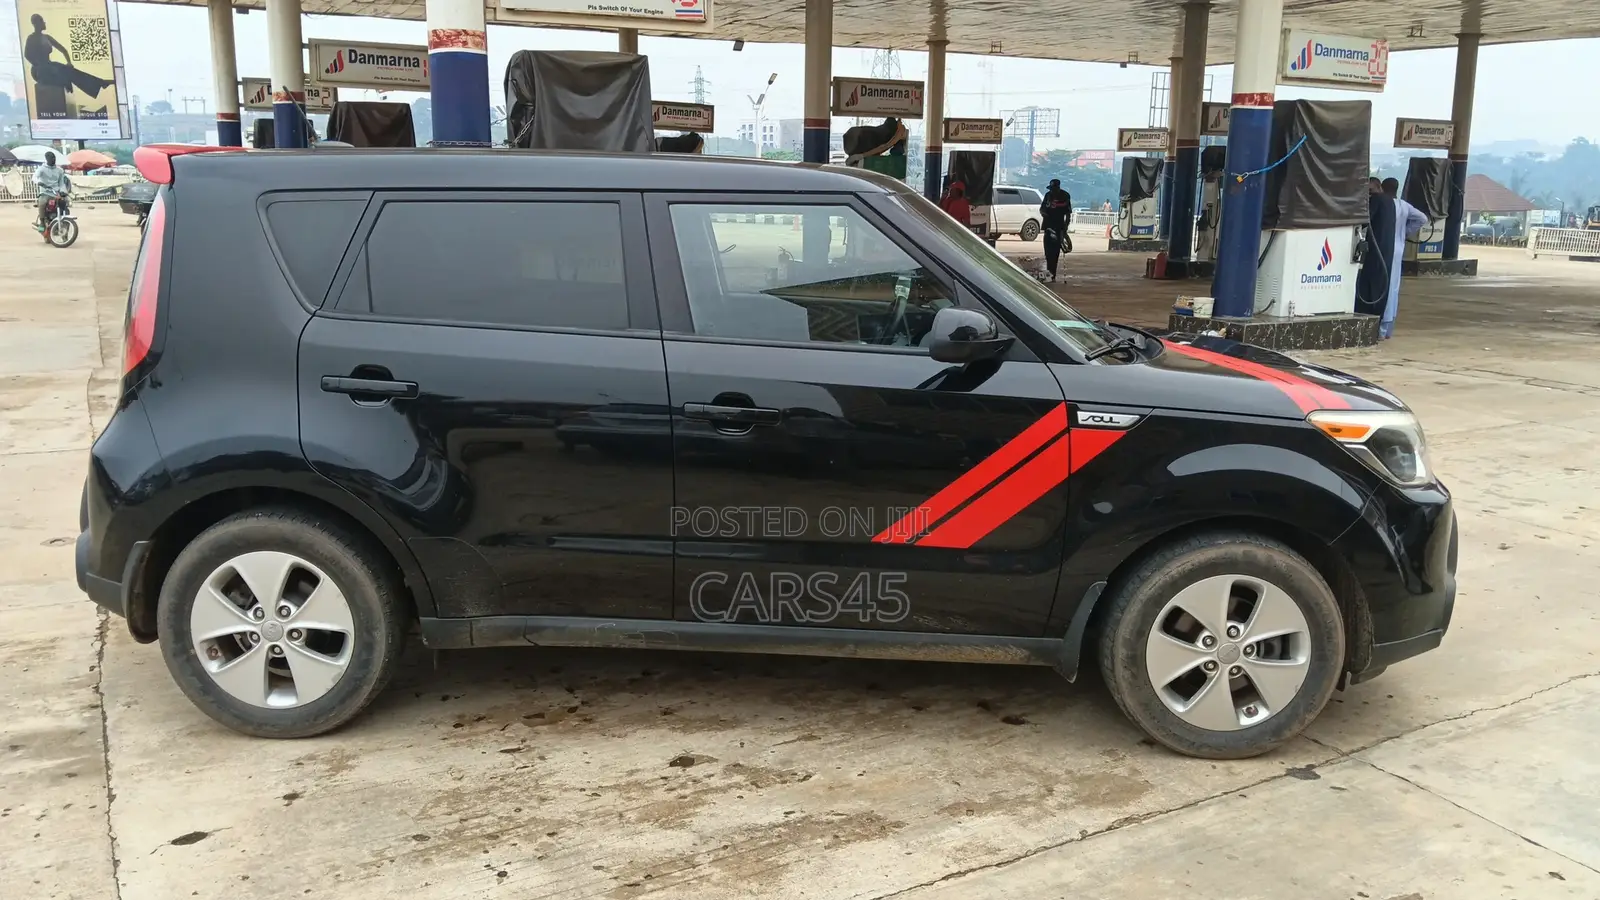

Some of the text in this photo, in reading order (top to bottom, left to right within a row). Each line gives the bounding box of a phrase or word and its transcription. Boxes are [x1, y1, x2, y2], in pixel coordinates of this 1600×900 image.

[348, 49, 420, 68] Danmarna
[1314, 42, 1389, 75] Danmarna 20
[860, 84, 910, 99] Danmarna
[661, 106, 702, 118] Danmarna
[960, 122, 993, 131] Danmarna
[1415, 124, 1445, 135] Danmarna
[1133, 131, 1160, 140] Danmarna
[1300, 273, 1342, 284] Danmarna
